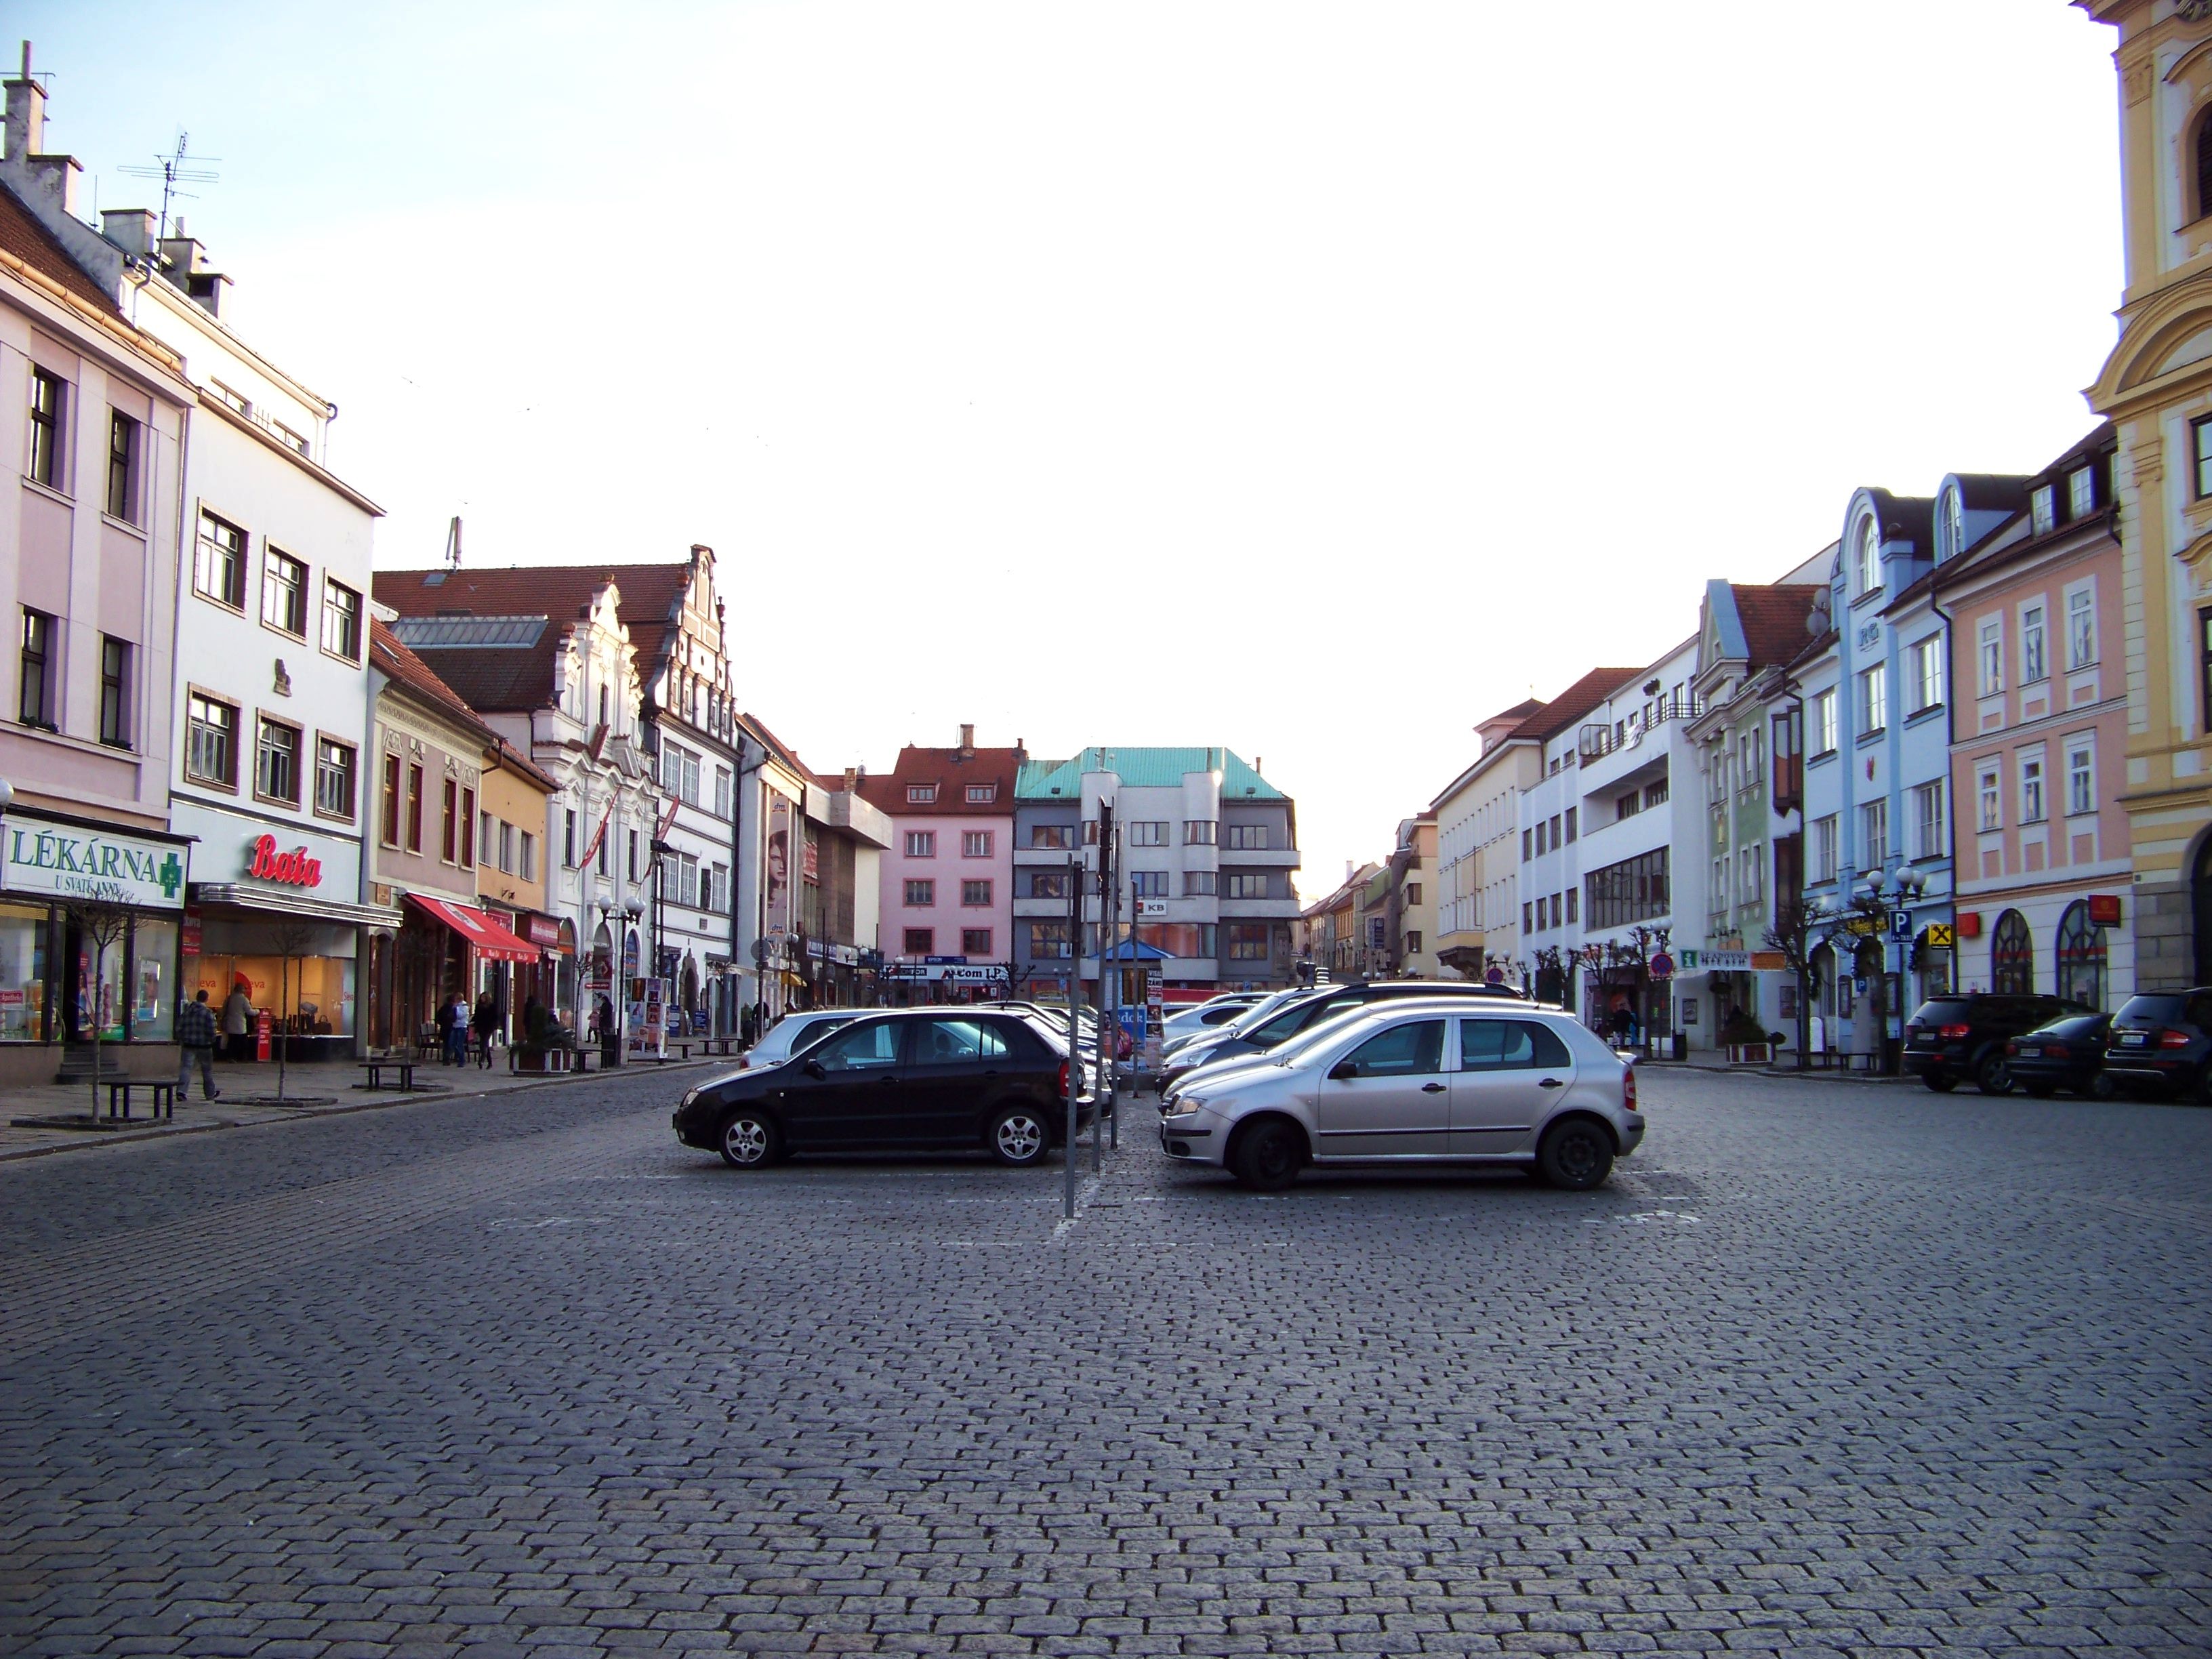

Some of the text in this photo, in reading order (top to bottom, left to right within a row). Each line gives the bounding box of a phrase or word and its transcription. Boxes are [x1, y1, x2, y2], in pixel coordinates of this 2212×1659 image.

[10, 830, 159, 884] LÉKÁRNA
[250, 833, 323, 888] Bata
[56, 875, 62, 889] U
[65, 876, 93, 893] SVATÉ
[1896, 913, 1907, 933] P
[1858, 981, 1865, 989] P
[1118, 1011, 1144, 1023] edok
